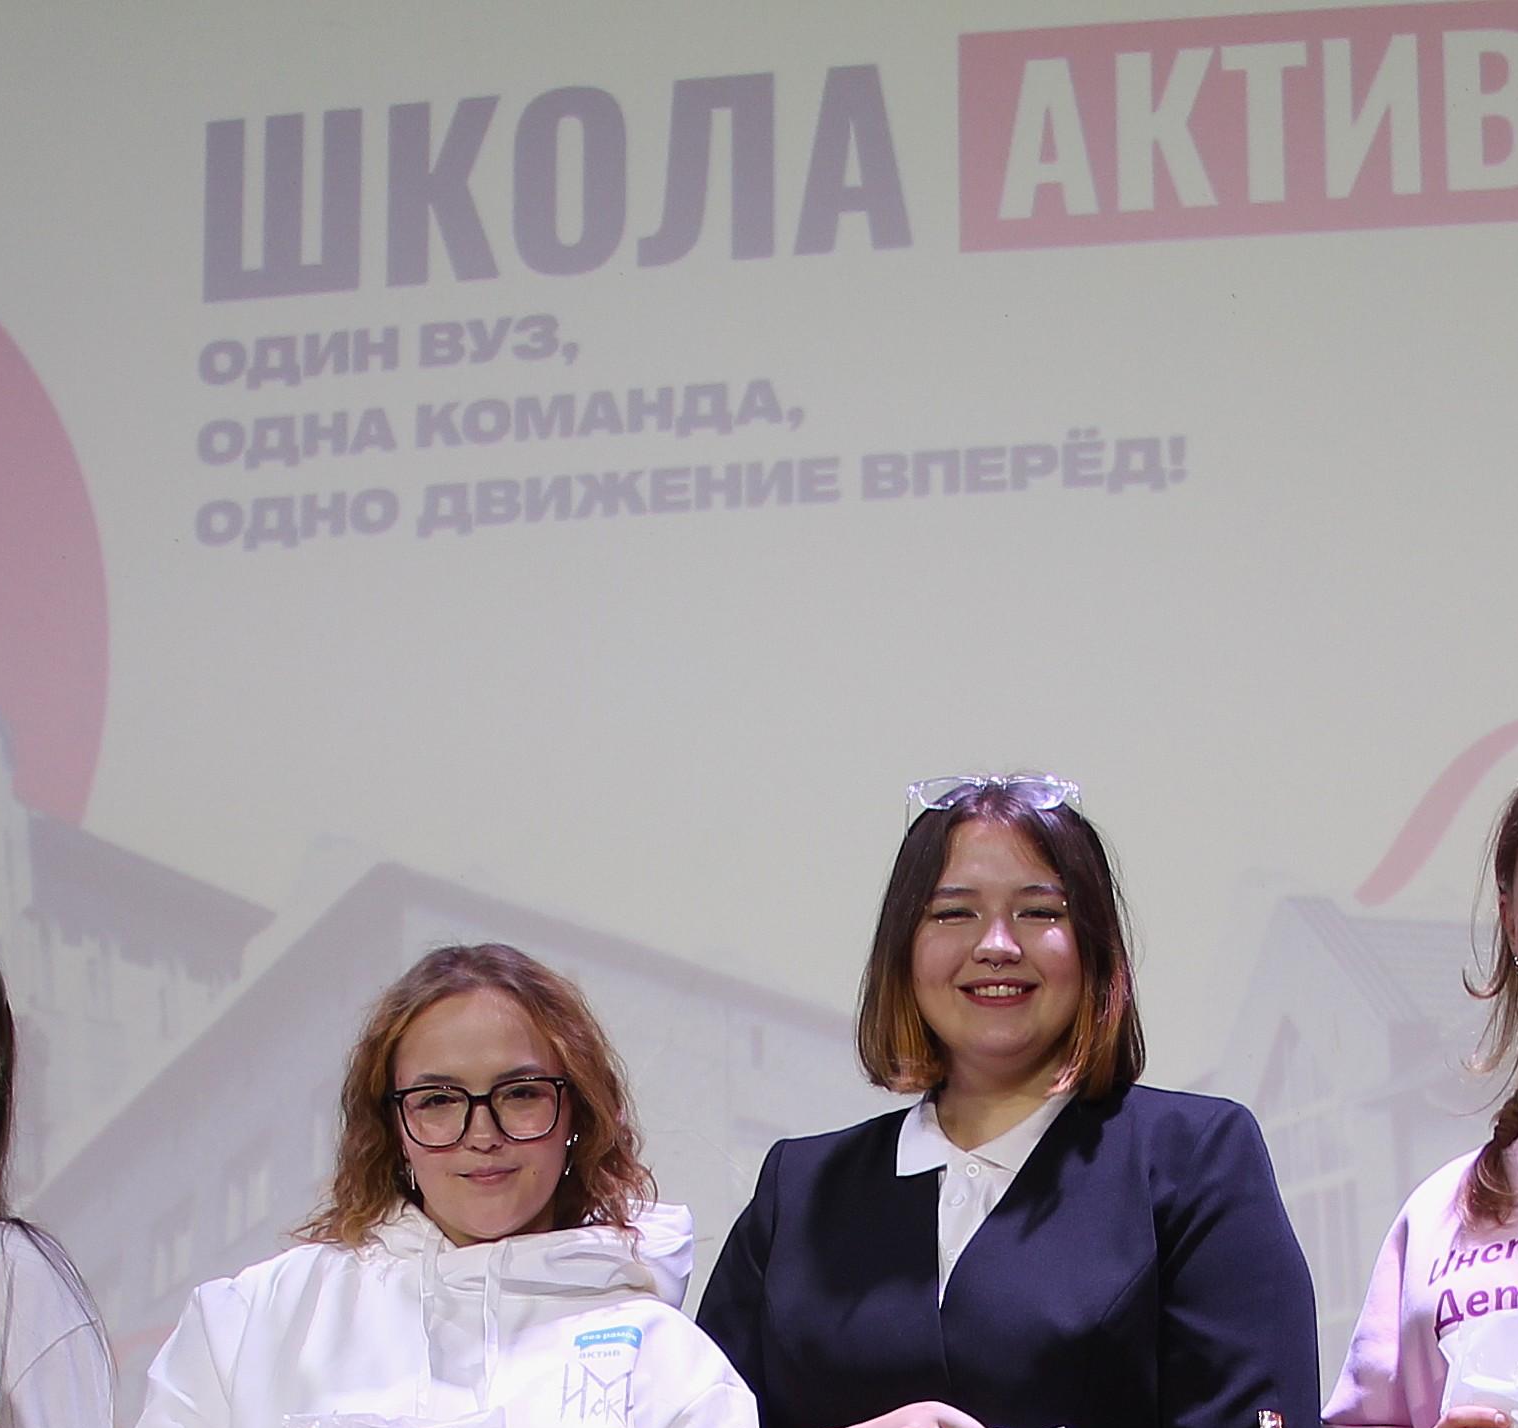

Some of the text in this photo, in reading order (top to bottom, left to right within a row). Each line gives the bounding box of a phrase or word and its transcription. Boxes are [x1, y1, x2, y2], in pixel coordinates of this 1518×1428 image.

[202, 64, 913, 303] ШКОЛА
[197, 314, 580, 389] ОДИН ВУЗ,
[195, 378, 805, 469] ОДНА КОМАНДА,
[193, 428, 1187, 551] ОДНО ДВИЖЕНИЕ ВПЕРЁД!
